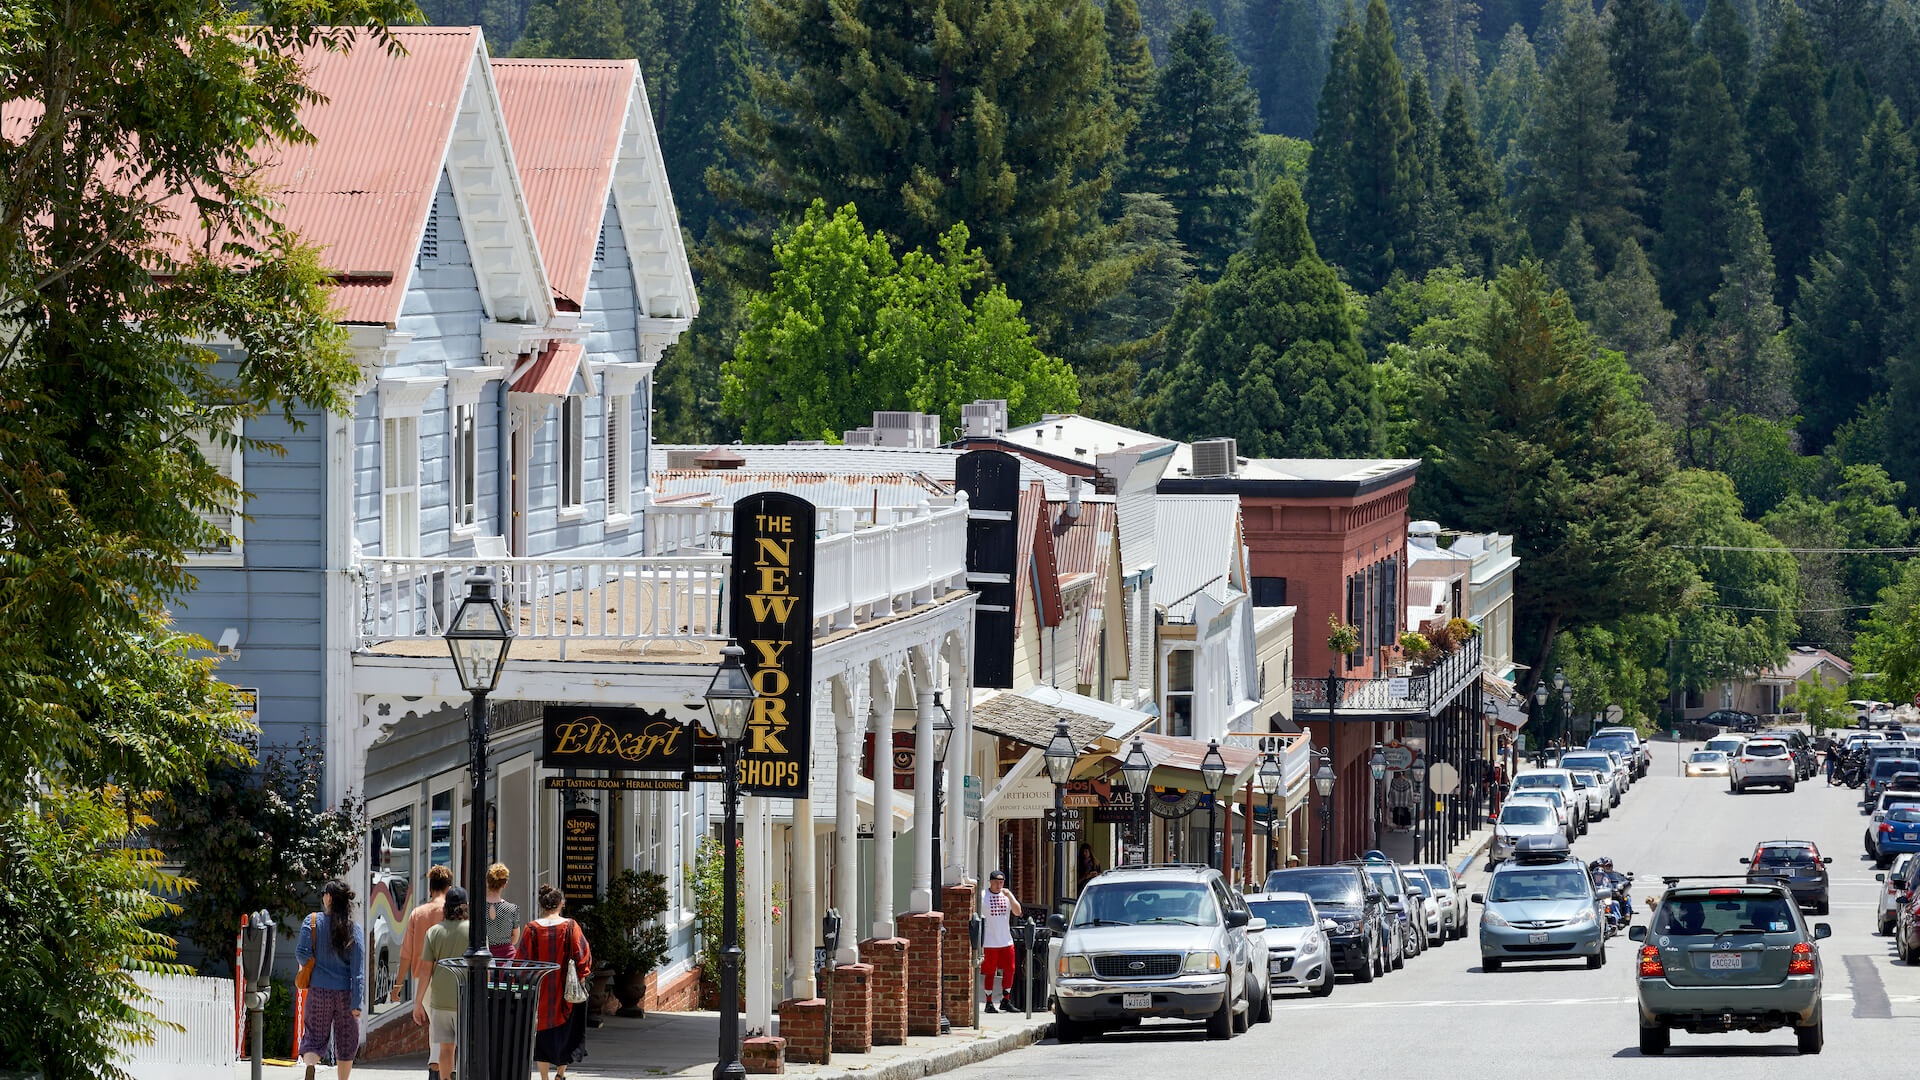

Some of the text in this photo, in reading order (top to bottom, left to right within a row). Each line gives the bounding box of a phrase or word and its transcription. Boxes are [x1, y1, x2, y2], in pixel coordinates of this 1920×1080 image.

[756, 514, 792, 533] THE
[745, 537, 800, 754] NEW YORK
[552, 715, 684, 762] Elixart
[738, 759, 799, 787] SHOPS
[551, 778, 684, 789] ART TASTING ROOM HERBAL LOUNGE
[1069, 809, 1079, 819] TO
[566, 819, 596, 831] Shops
[1047, 820, 1080, 830] PAKING
[1050, 831, 1076, 841] SOPS
